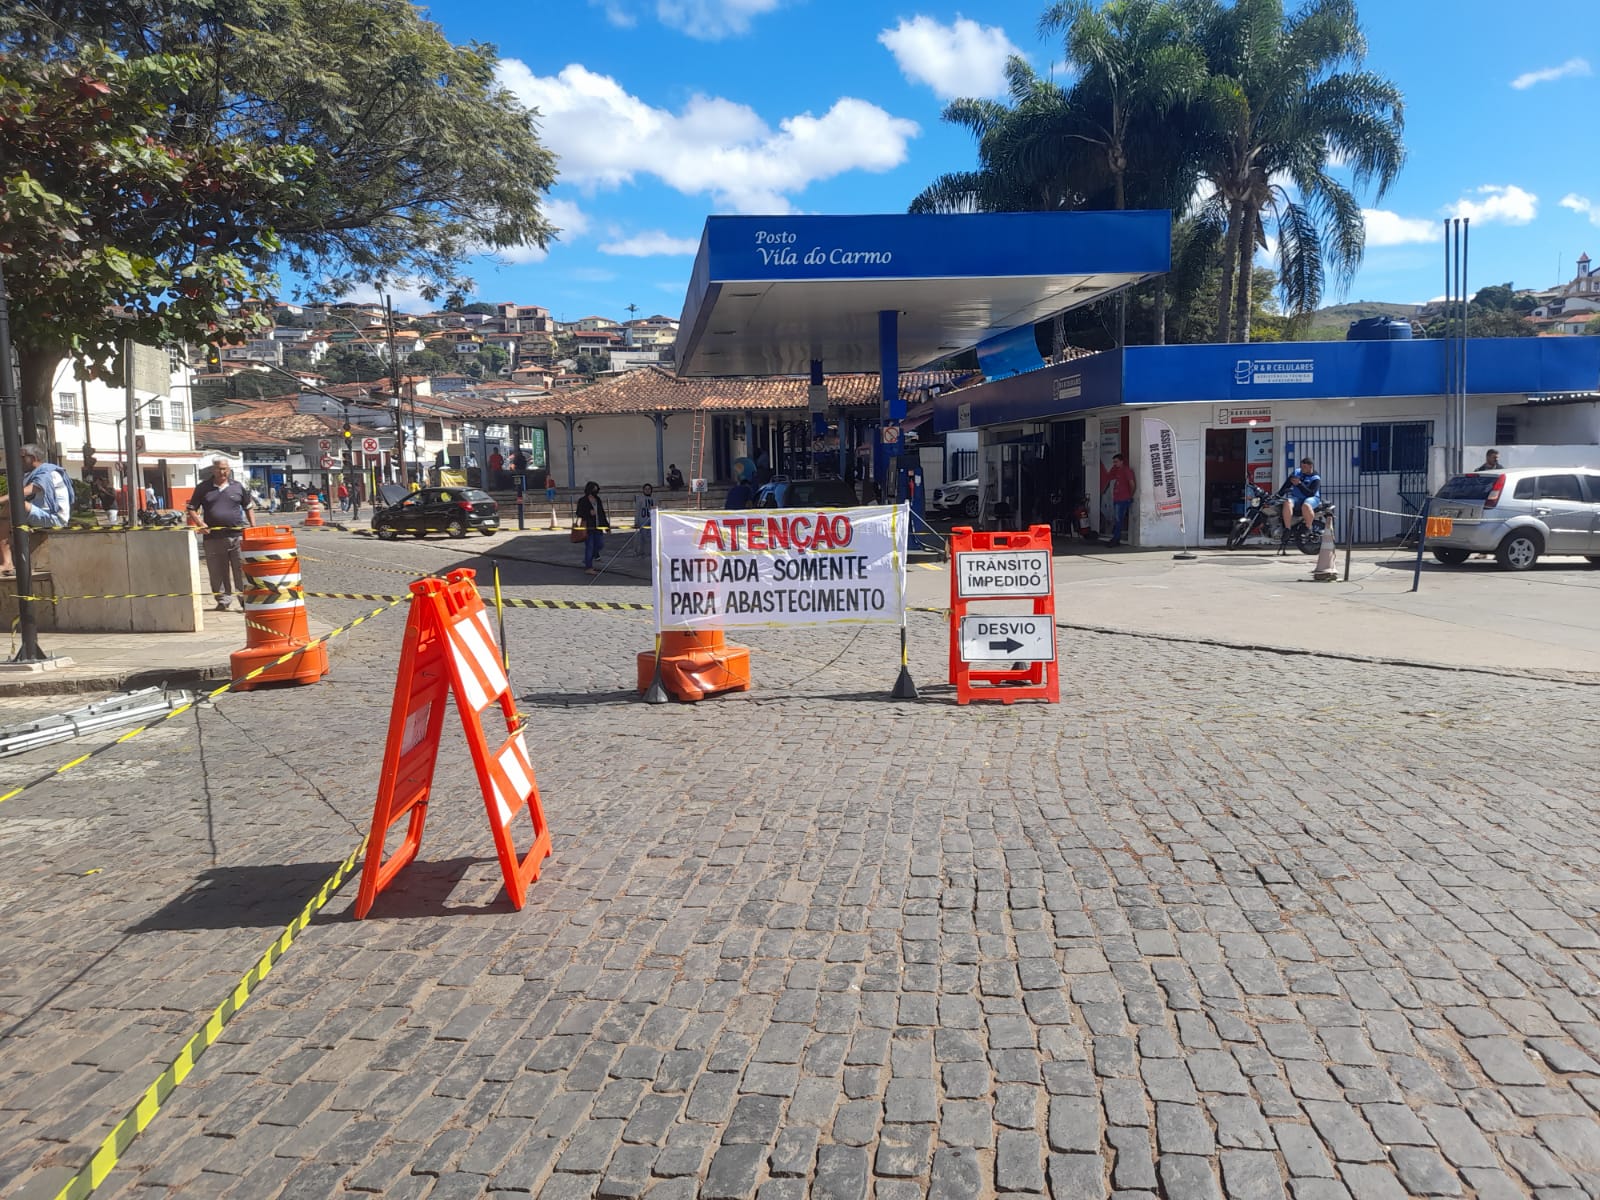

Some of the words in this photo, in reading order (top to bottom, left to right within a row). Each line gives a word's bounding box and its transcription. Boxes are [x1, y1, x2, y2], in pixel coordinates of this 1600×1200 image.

[755, 231, 797, 244] Posto
[756, 247, 798, 265] Vila
[803, 246, 826, 265] do
[829, 248, 892, 265] Carmo
[1273, 363, 1314, 371] CELULARES
[1149, 443, 1159, 452] DE
[1160, 429, 1173, 471] ASSISTÊNCIA
[1151, 452, 1163, 487] CELULARES
[1165, 471, 1176, 498] TÉCNICA
[697, 512, 854, 554] ATENÇÃO
[670, 557, 760, 582] ENTRADA
[773, 555, 869, 582] SOMENTE
[966, 557, 1042, 571] TRÂNSITO
[968, 575, 1041, 587] IMPEDIDO
[671, 590, 717, 615] PARA
[725, 588, 885, 614] ABASTECIMENTO
[978, 623, 1035, 635] DESVIO
